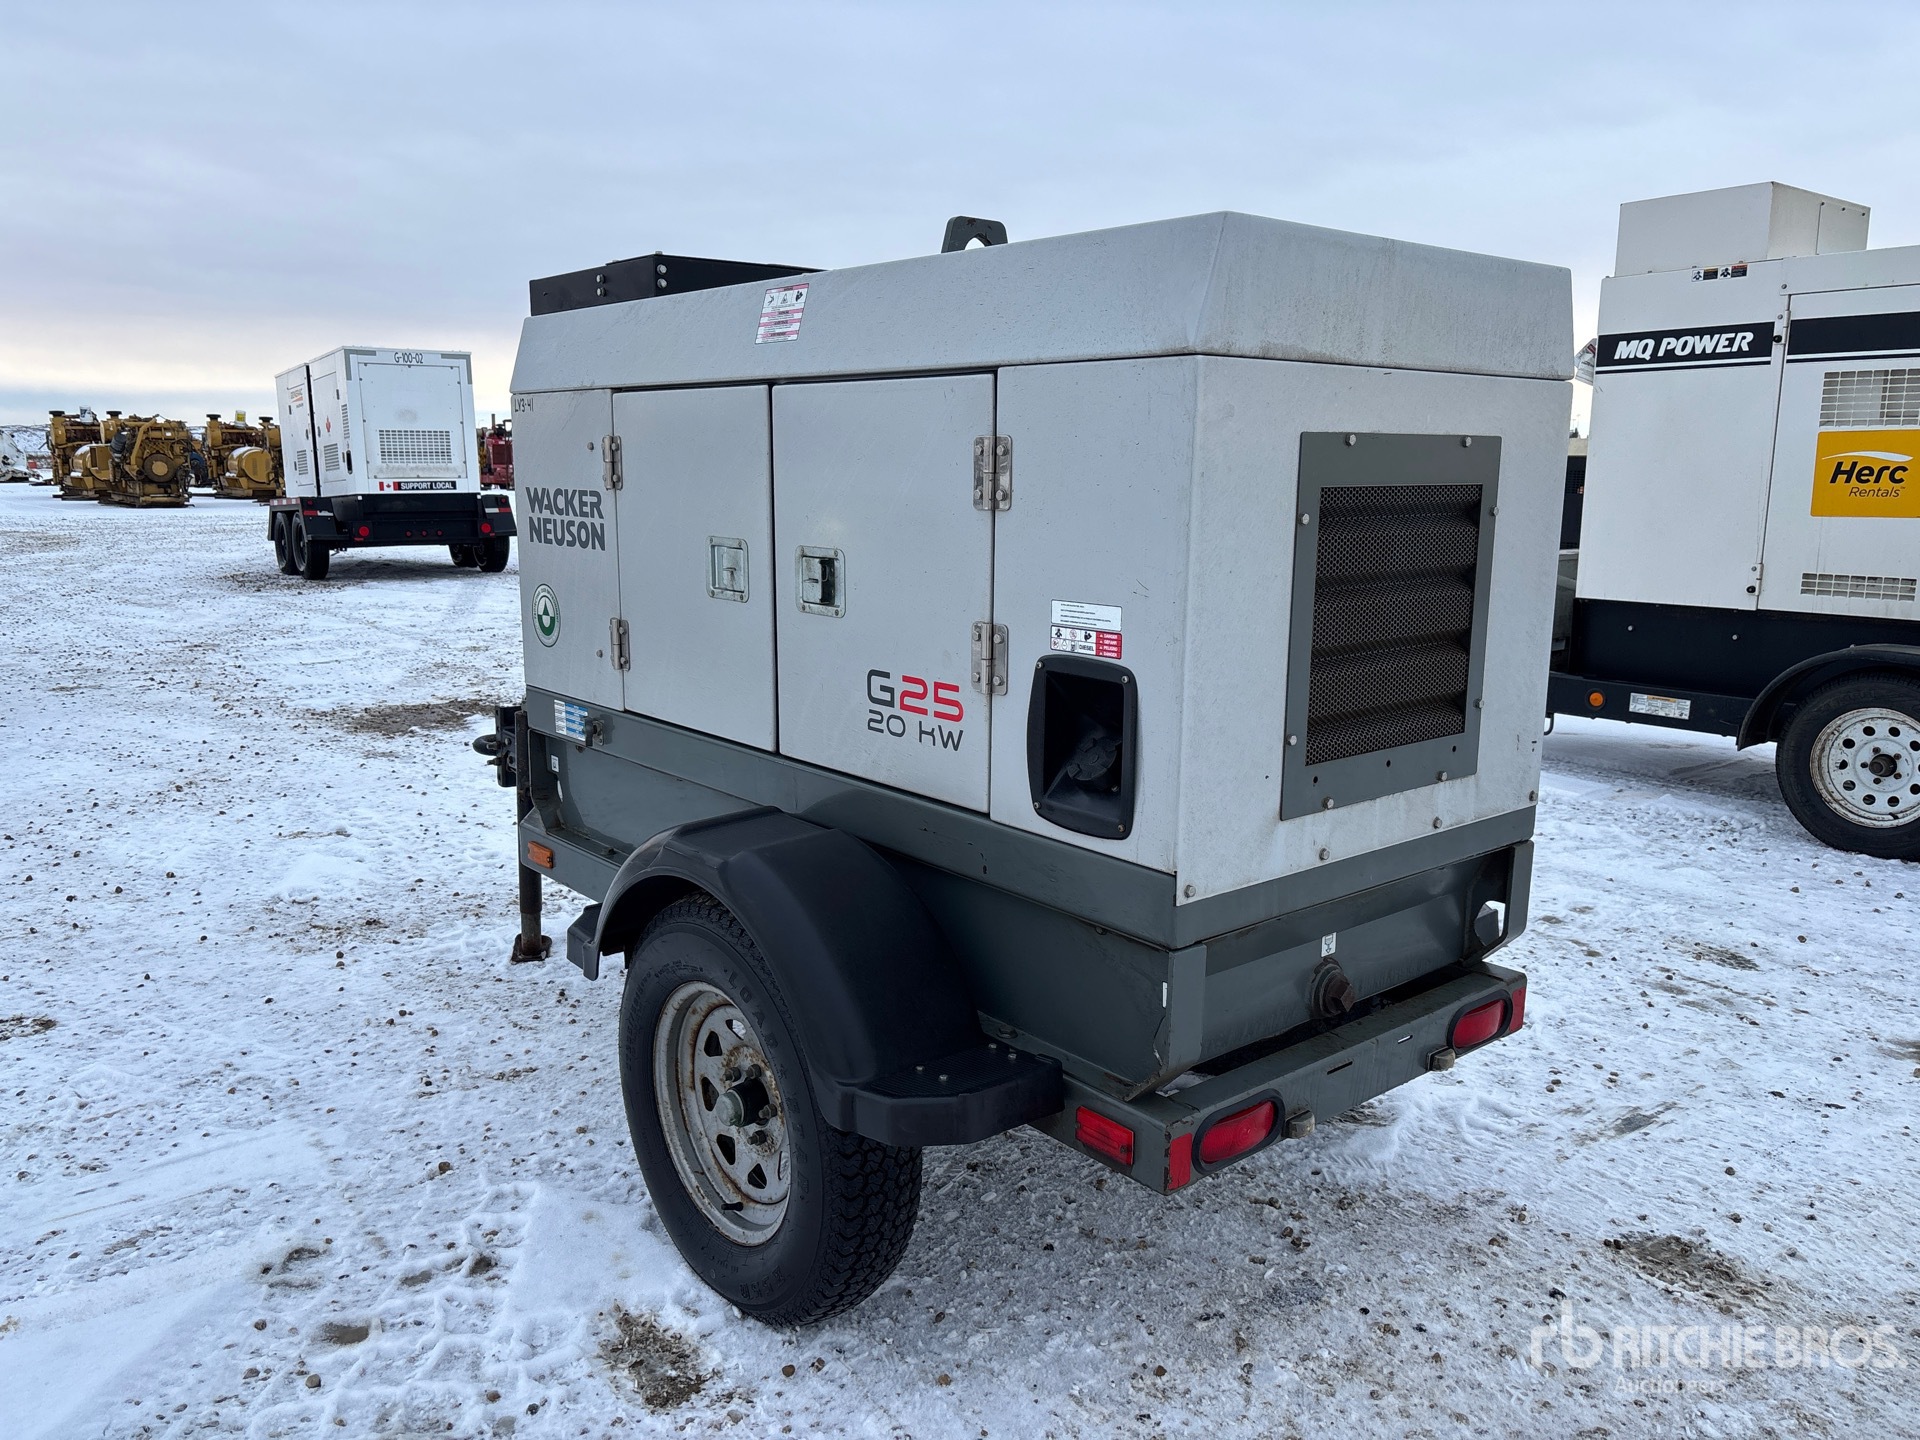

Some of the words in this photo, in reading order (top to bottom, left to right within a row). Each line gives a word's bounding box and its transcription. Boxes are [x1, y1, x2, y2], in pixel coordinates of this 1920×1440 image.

[394, 352, 423, 364] G-100-02
[1613, 339, 1655, 361] MQ
[1657, 331, 1754, 357] POWER
[1829, 461, 1909, 484] Herc
[400, 482, 431, 490] SUPPORT
[1848, 486, 1901, 498] Rentals
[525, 487, 604, 519] WACKER
[528, 516, 605, 551] NEUSON
[1079, 644, 1095, 652] DIESEL
[866, 669, 964, 723] G25
[867, 709, 906, 738] 20
[919, 720, 964, 752] kW
